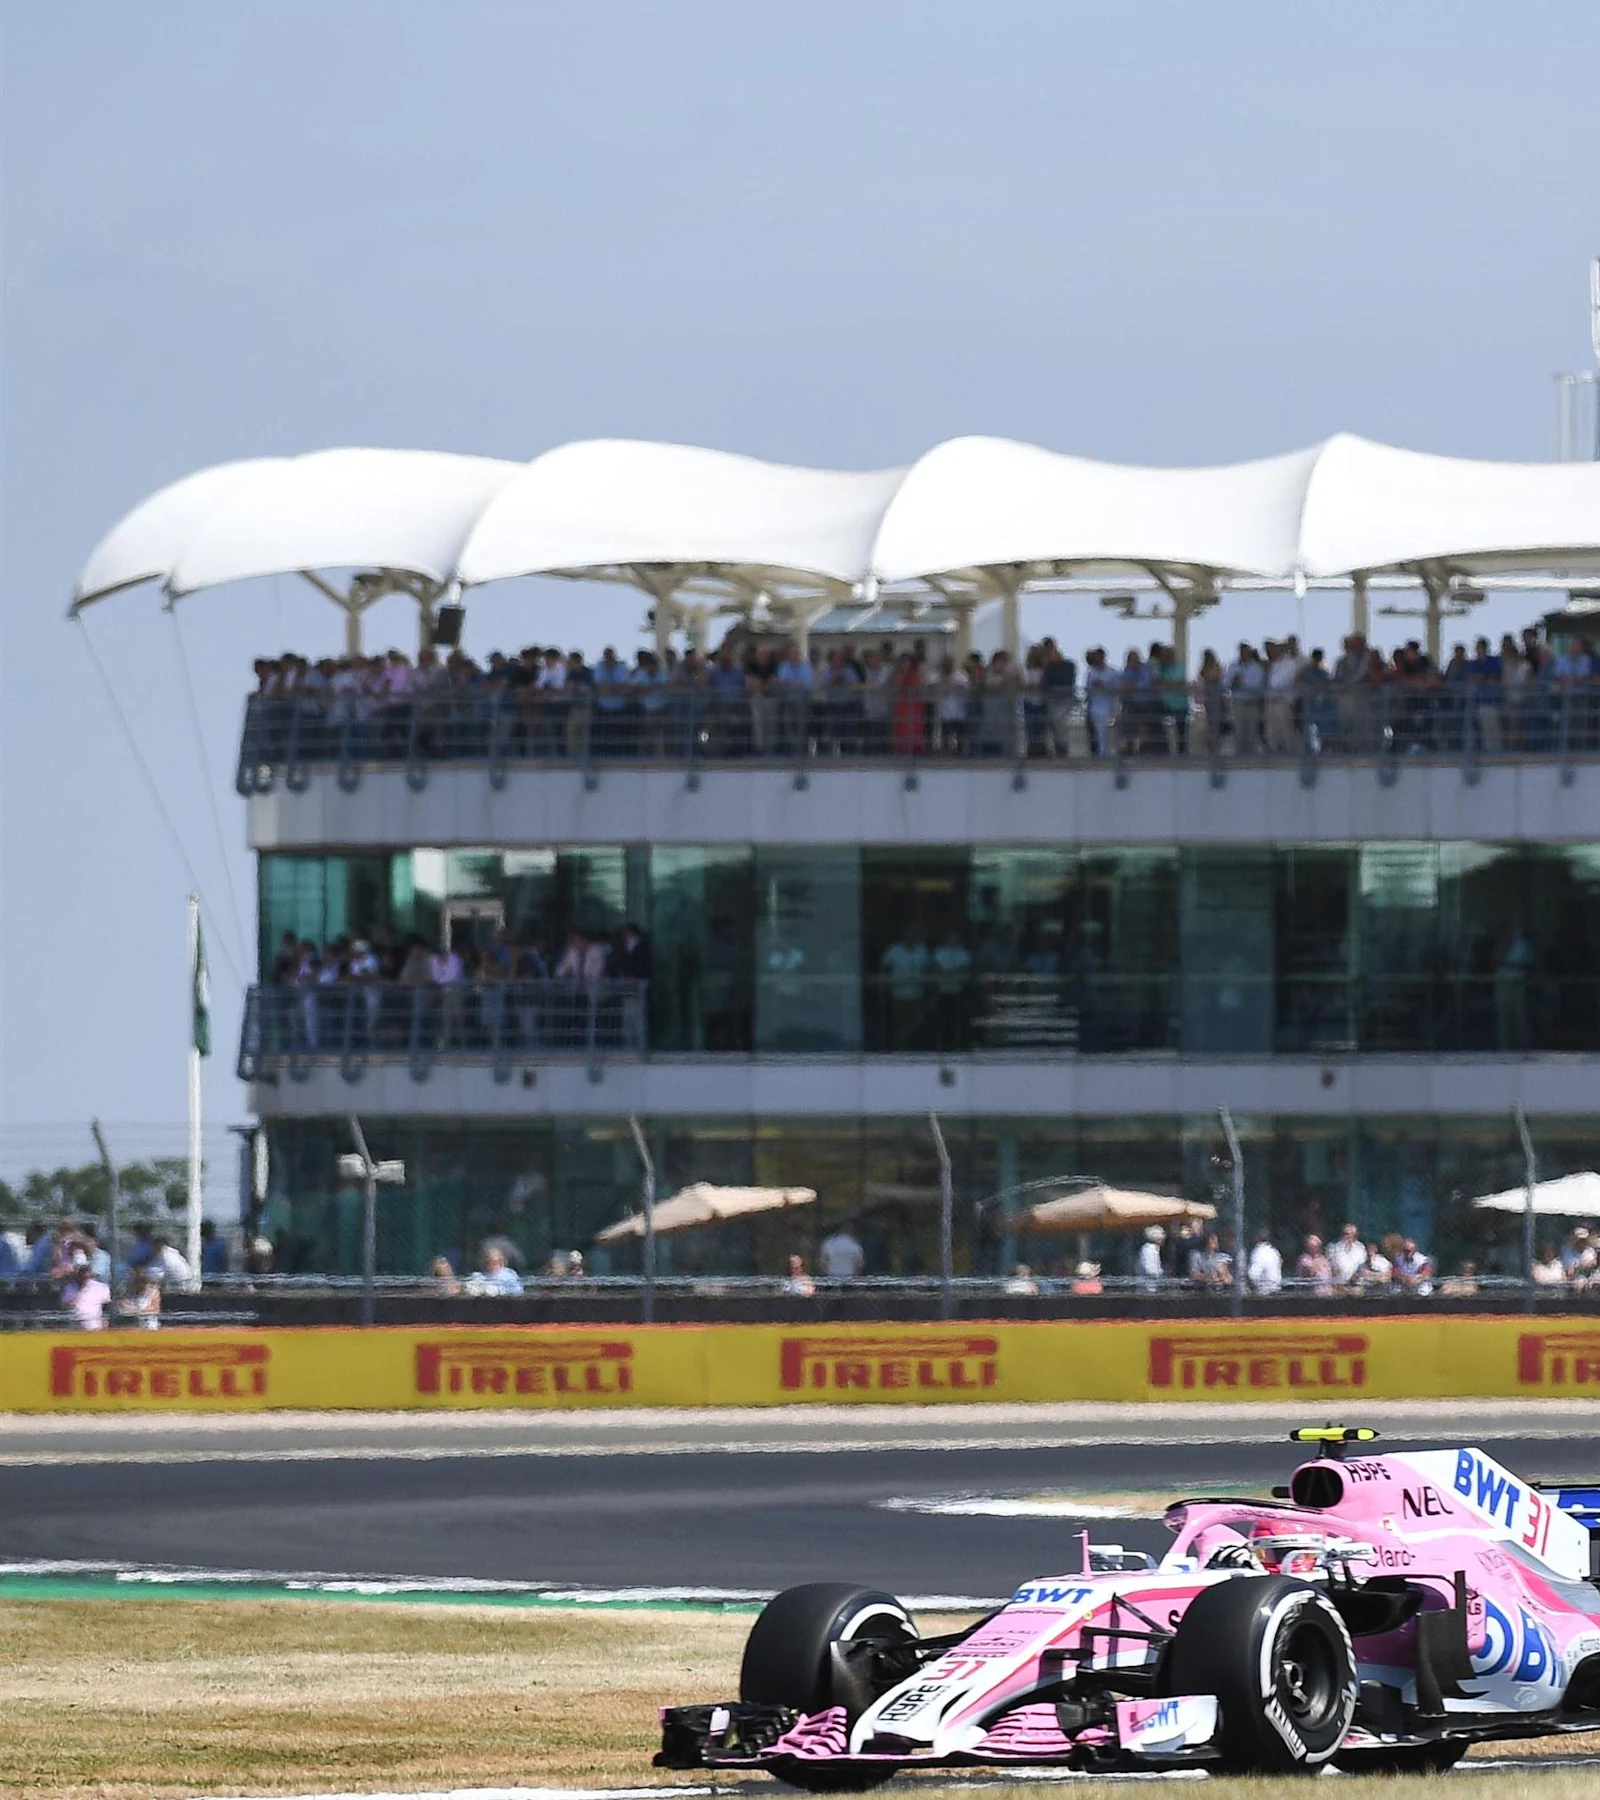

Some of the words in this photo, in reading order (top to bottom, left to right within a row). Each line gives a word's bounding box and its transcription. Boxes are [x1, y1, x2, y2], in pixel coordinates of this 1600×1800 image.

[50, 1344, 270, 1397] PIRELLI
[415, 1341, 633, 1394] PIRELLI
[780, 1336, 997, 1389] PIRELLI
[1149, 1334, 1368, 1387] PIRELLI
[1344, 1462, 1392, 1484] HYPE
[1453, 1448, 1521, 1529] BWT
[1522, 1491, 1551, 1556] 31
[1012, 1587, 1093, 1604] BWT
[921, 1660, 987, 1682] 31
[878, 1684, 942, 1722] HYPE
